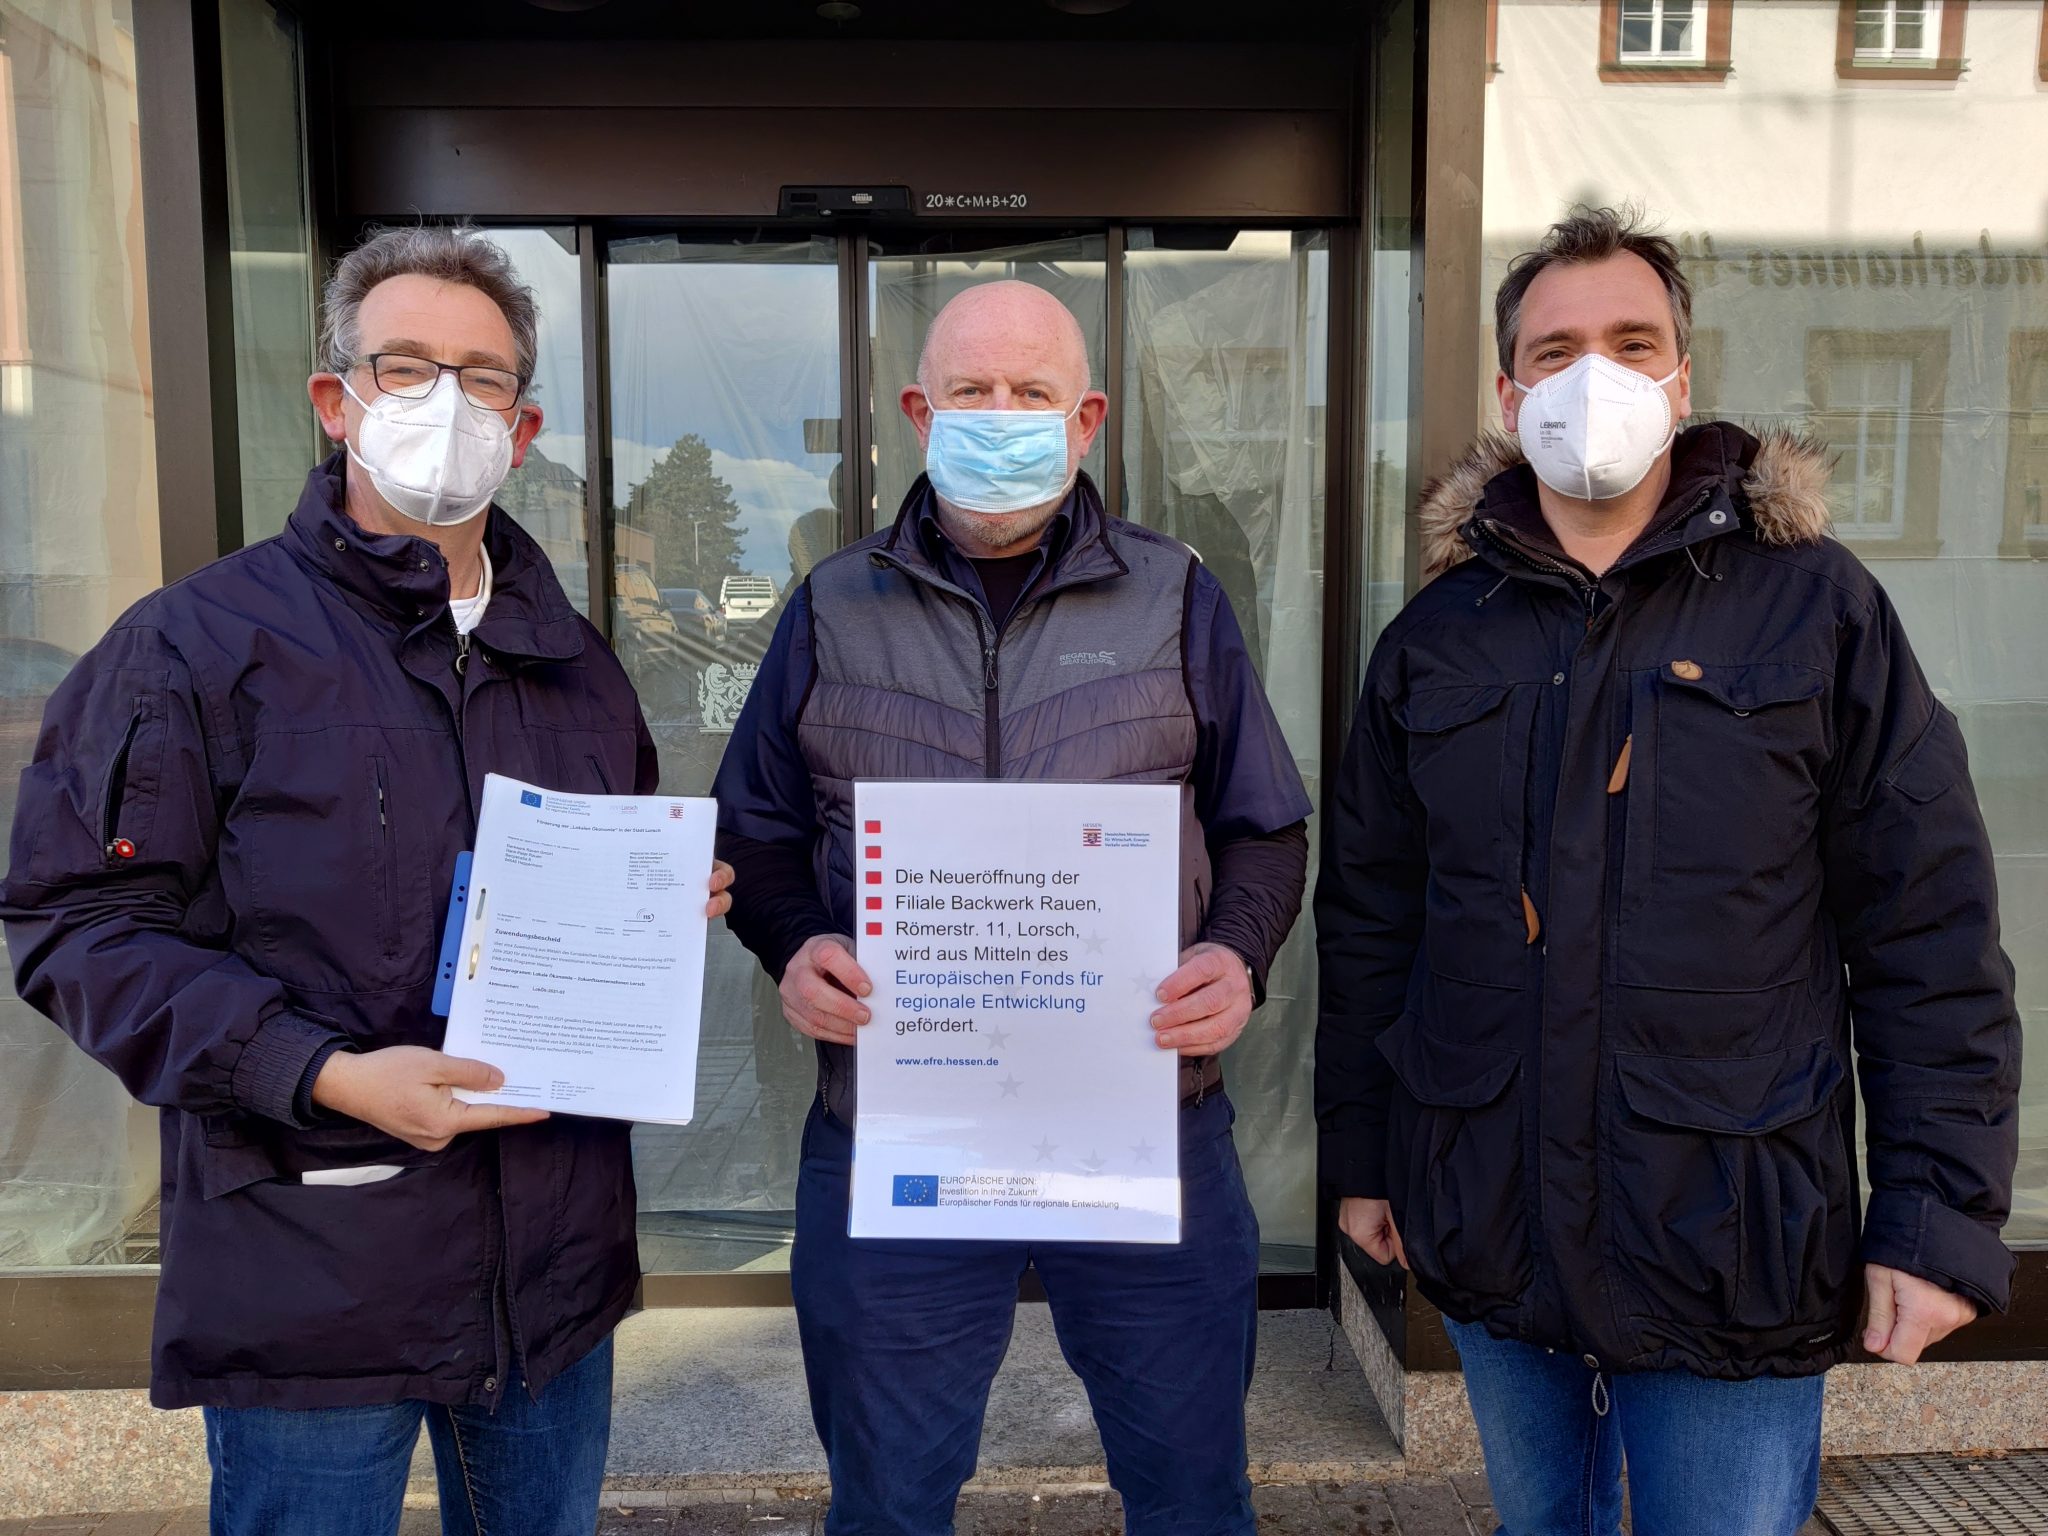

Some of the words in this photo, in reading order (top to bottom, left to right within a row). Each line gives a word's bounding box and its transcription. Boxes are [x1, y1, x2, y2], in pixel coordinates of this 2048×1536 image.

[1059, 652, 1098, 662] REGATTA
[896, 869, 923, 884] Die
[930, 869, 1045, 888] Neueröffnung
[1051, 870, 1080, 884] der
[896, 895, 945, 910] Filiale
[952, 895, 1034, 910] Backwerk
[1040, 896, 1101, 913] Rauen,
[495, 928, 561, 943] Zuwendungsbescheid
[896, 921, 979, 936] Römerstr.
[986, 921, 1011, 938] 11,
[1018, 922, 1080, 939] Lorsch,
[895, 946, 930, 961] wird
[937, 949, 968, 961] aus
[974, 946, 1031, 961] Mitteln
[1037, 947, 1068, 961] des
[896, 969, 1014, 988] Europäischen
[1021, 970, 1074, 986] Fonds
[1081, 970, 1104, 986] für
[895, 994, 975, 1012] regionale
[982, 994, 1086, 1013] Entwicklung
[895, 1017, 978, 1036] gefördert.
[895, 1057, 999, 1066] www.efre.hessen.de
[940, 1175, 1003, 1185] EUROPÄISCHE
[939, 1188, 979, 1196] Investition
[981, 1188, 988, 1196] in
[990, 1188, 1006, 1196] Ihre
[1008, 1188, 1037, 1197] Zukunft
[939, 1198, 991, 1208] Europäischer
[993, 1199, 1018, 1207] Fonds
[1020, 1199, 1031, 1207] für
[1033, 1199, 1069, 1209] regionale
[1071, 1200, 1120, 1210] Entwicklung
